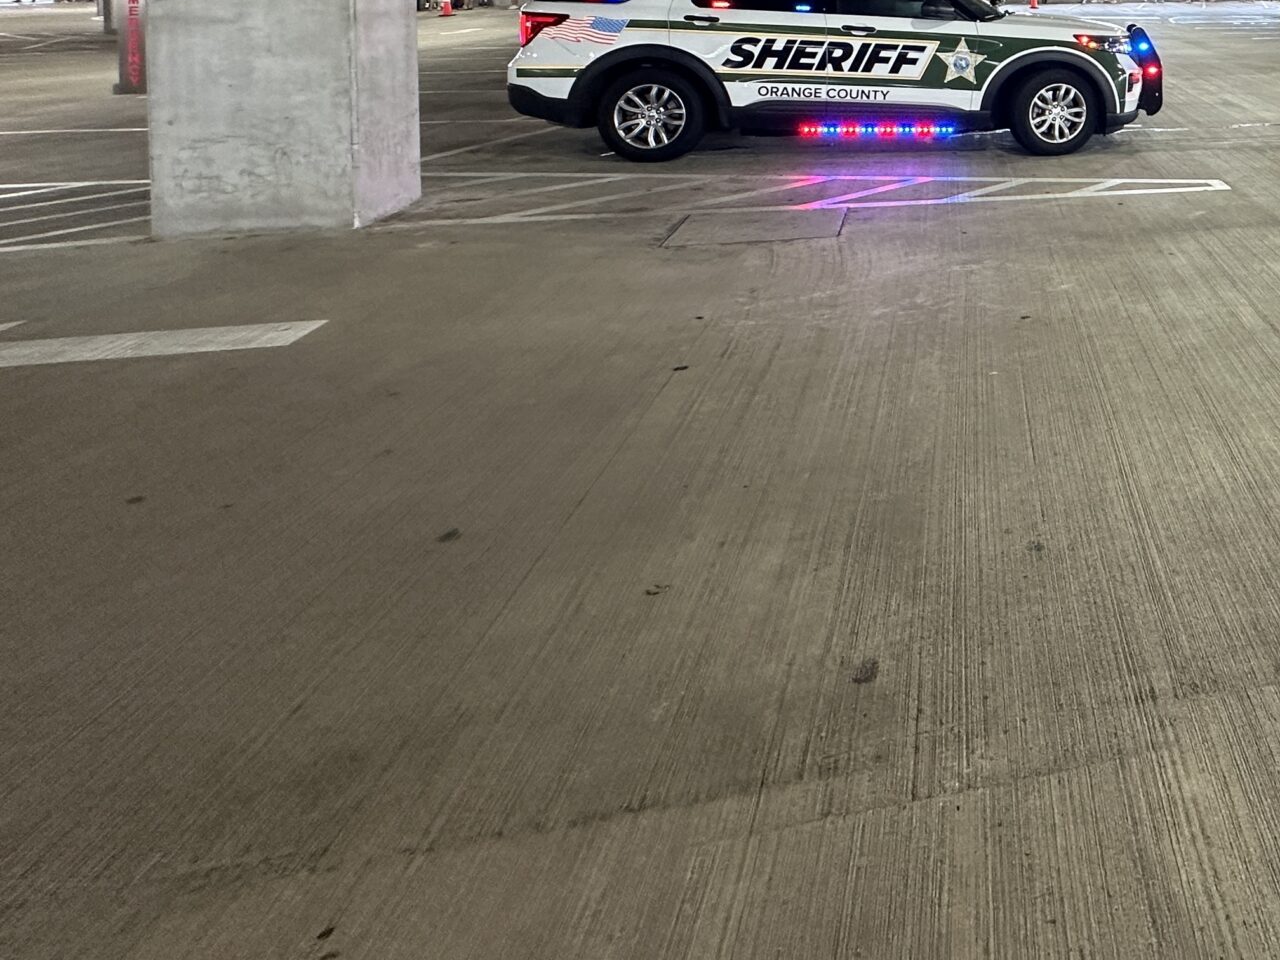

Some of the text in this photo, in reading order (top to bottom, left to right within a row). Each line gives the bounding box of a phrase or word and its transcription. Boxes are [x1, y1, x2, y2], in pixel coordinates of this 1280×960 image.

[721, 36, 928, 75] SHERIFF
[757, 85, 890, 101] ORANGE COUNTY
